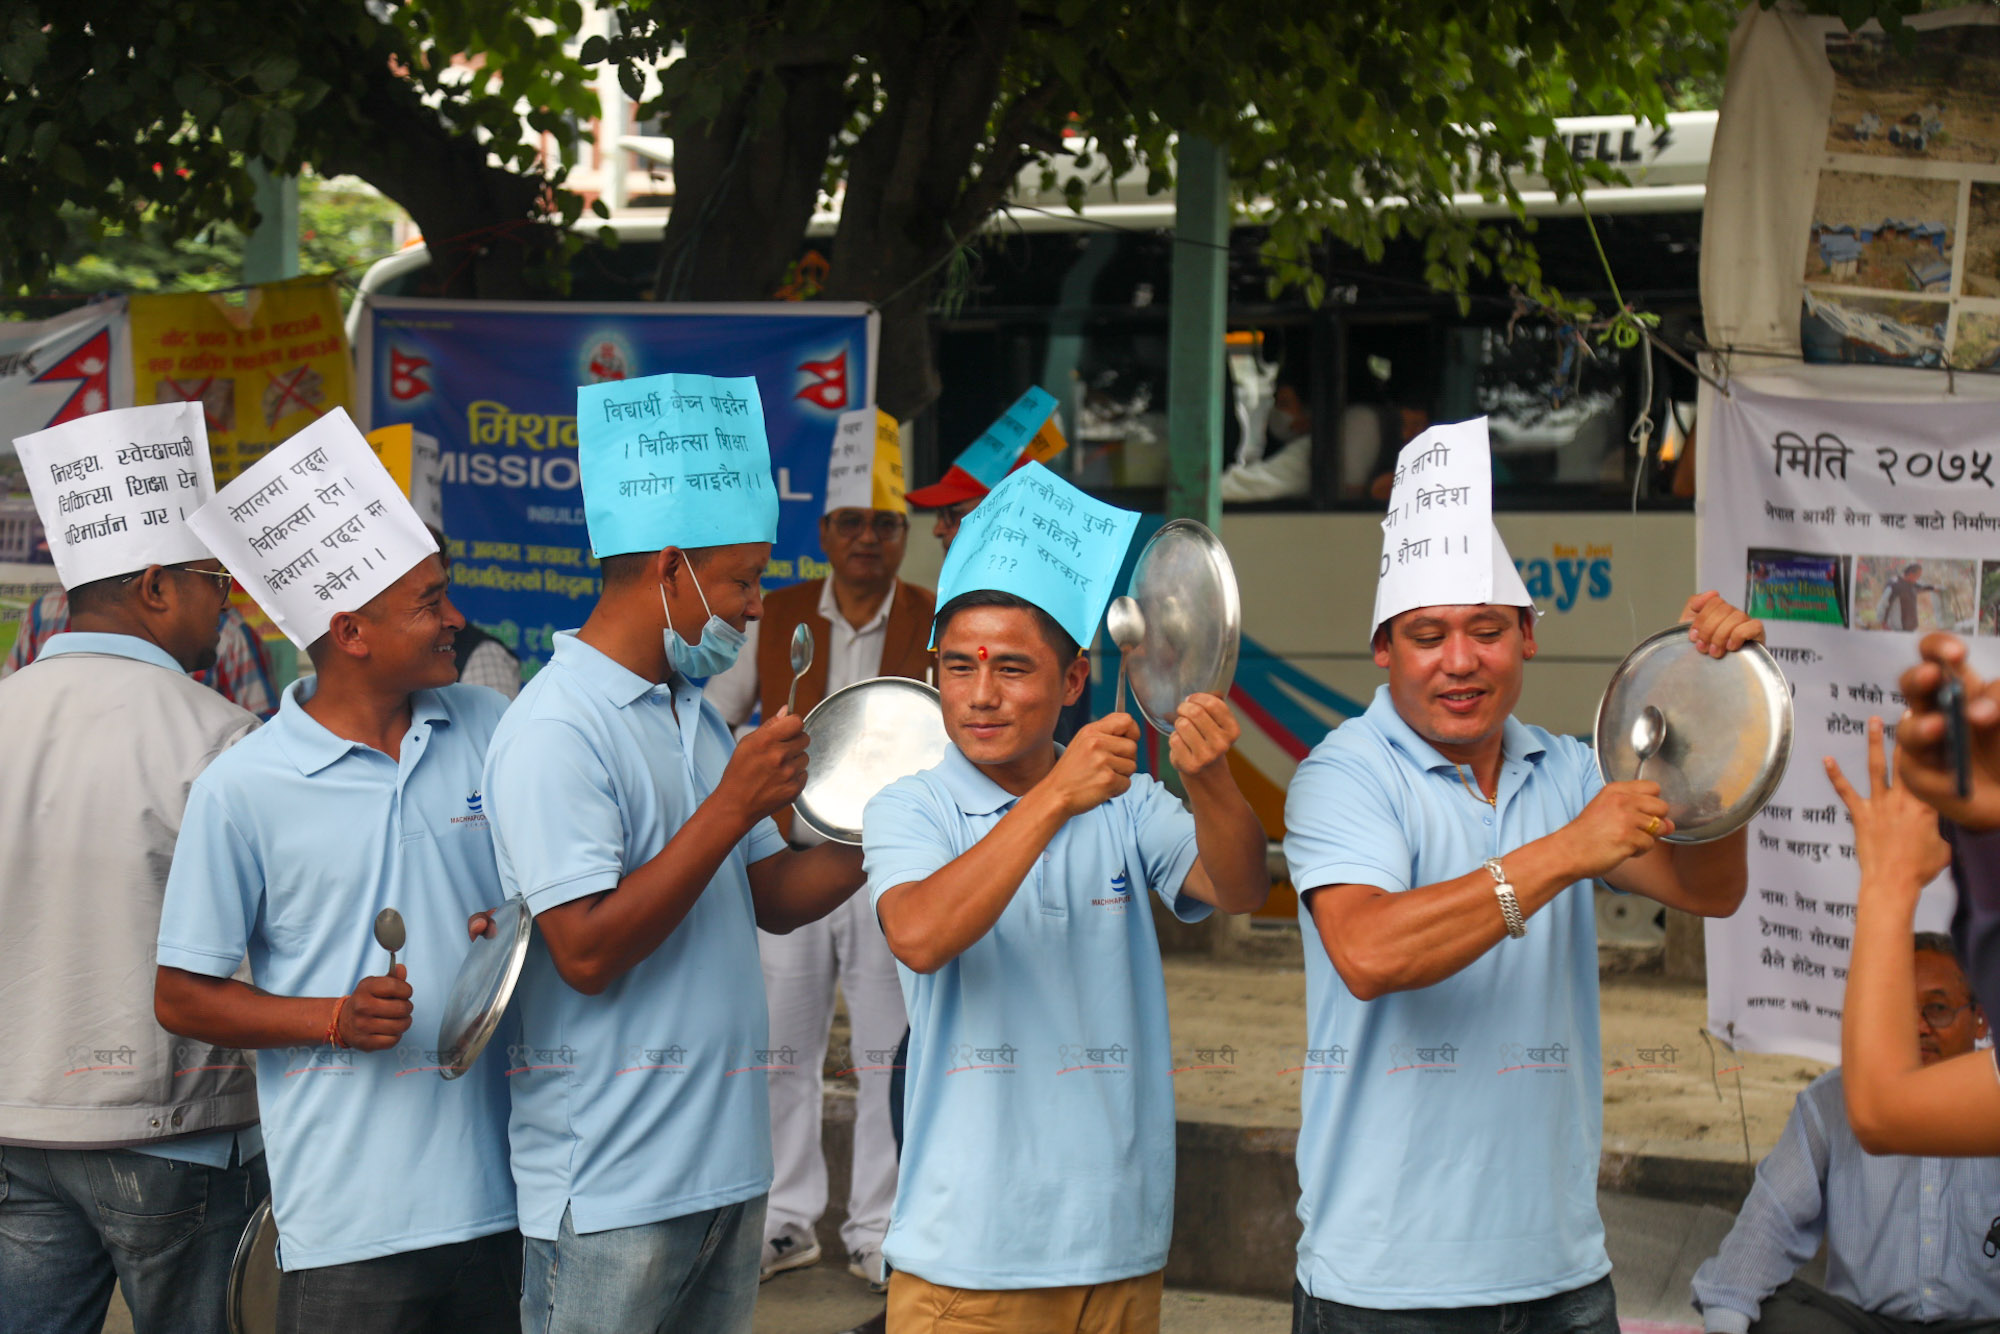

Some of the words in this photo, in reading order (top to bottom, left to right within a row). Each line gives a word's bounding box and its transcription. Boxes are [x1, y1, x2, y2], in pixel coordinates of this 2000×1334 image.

[603, 392, 661, 423] विद्यार्थी
[639, 431, 709, 457] चिकित्सा
[715, 427, 749, 452] शिक्षा
[1772, 431, 1854, 481] मिति
[1877, 447, 1995, 489] २०७५
[58, 486, 113, 516] चिकित्सा
[126, 475, 169, 497] शिक्षा
[227, 475, 289, 523] नेपालमा
[619, 472, 675, 497] आयोग
[1416, 483, 1471, 514] विदेश
[65, 514, 128, 546] परिमार्जन
[248, 503, 317, 558] चिकित्सा
[264, 548, 320, 595] विदेशमा
[364, 500, 388, 518] मन
[314, 565, 361, 601] बेचैन
[1037, 545, 1093, 592] सरकार
[1513, 558, 1612, 613] ays
